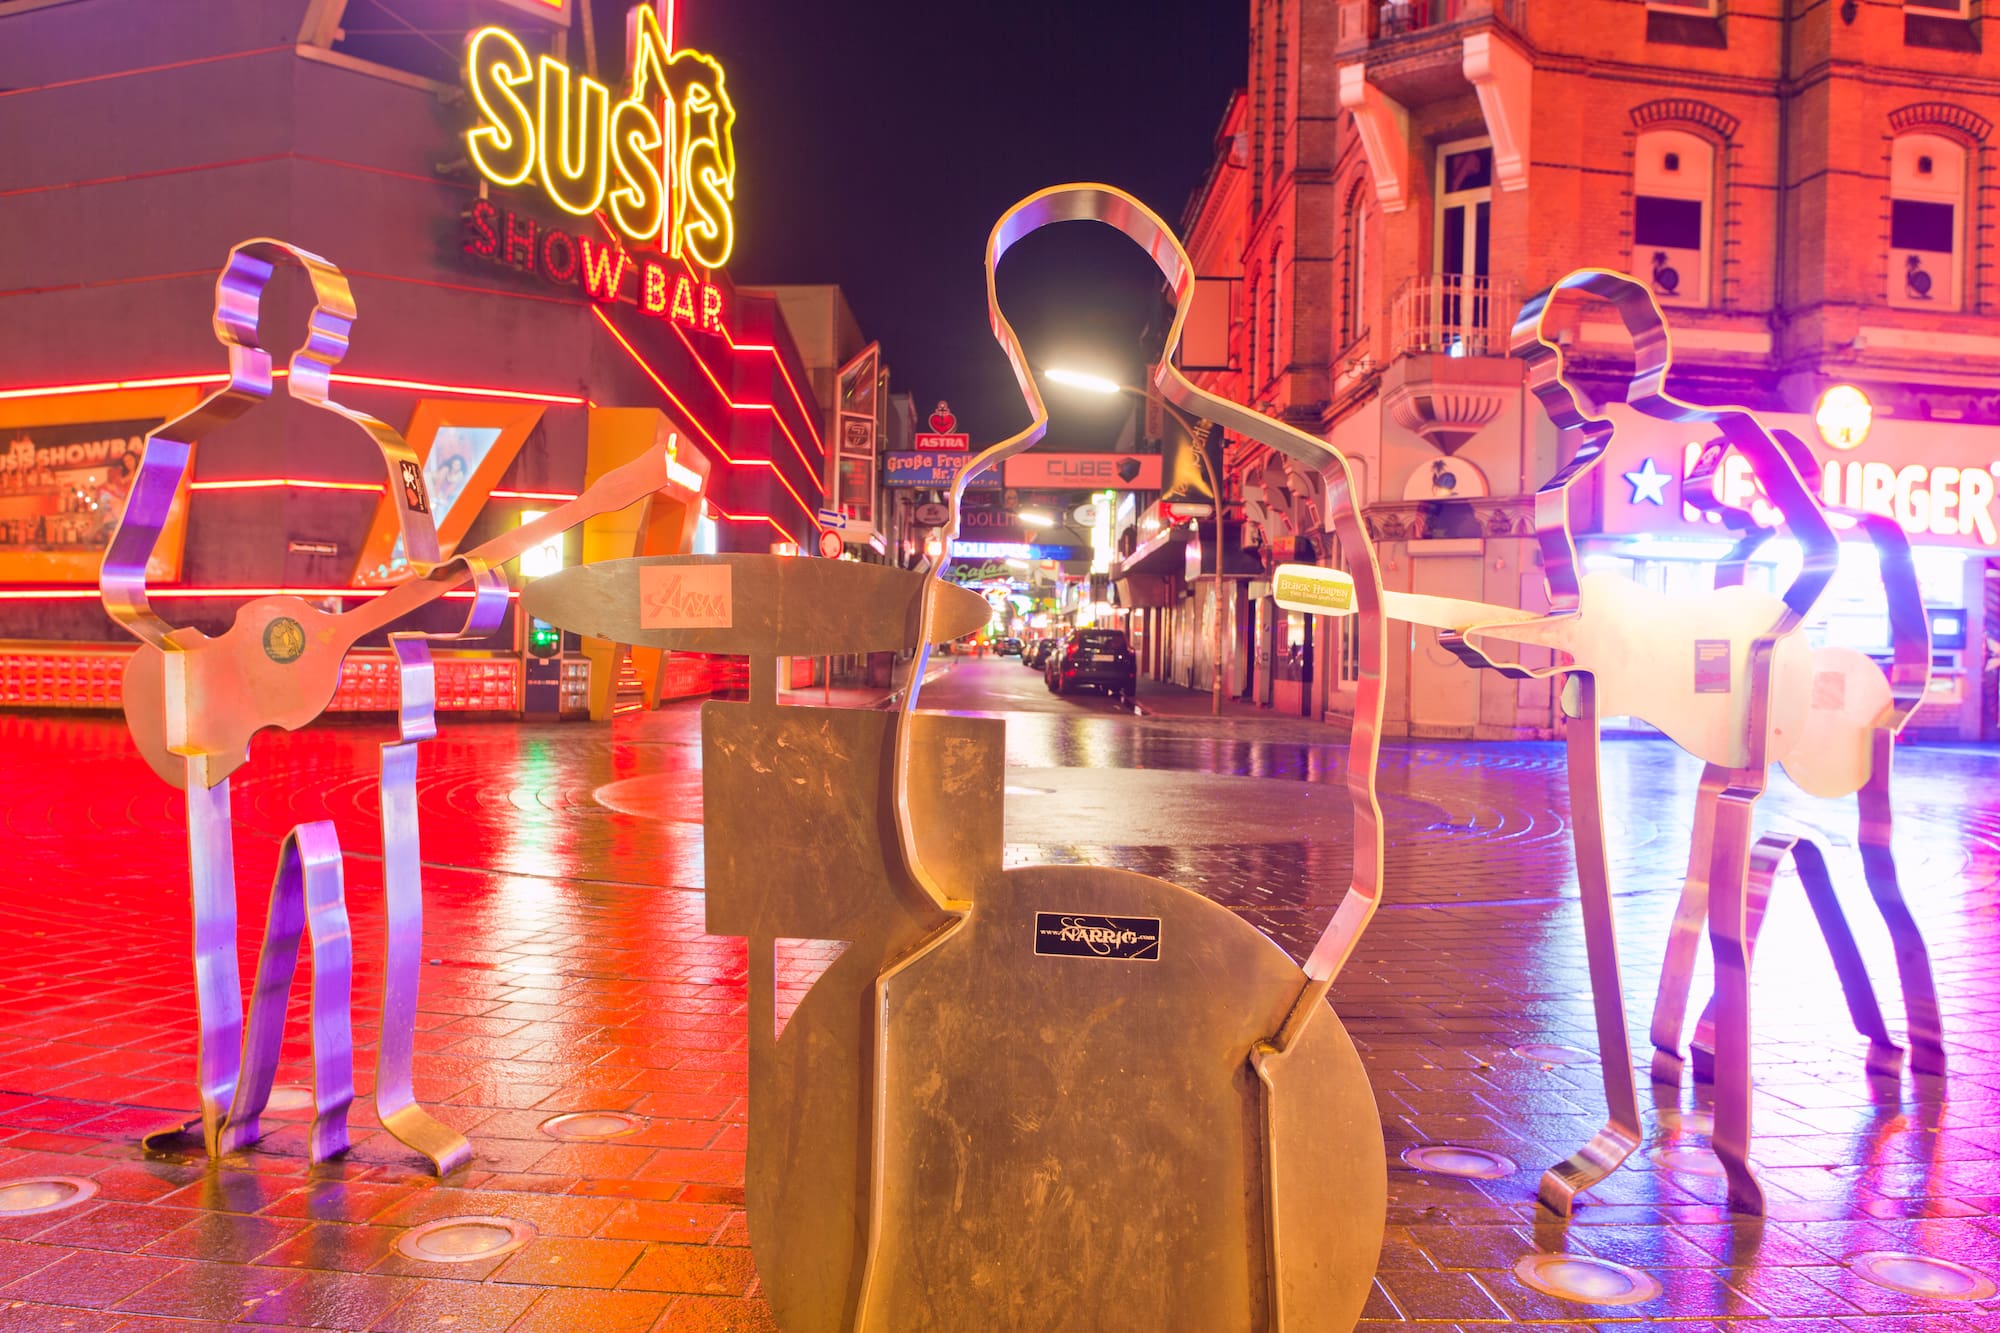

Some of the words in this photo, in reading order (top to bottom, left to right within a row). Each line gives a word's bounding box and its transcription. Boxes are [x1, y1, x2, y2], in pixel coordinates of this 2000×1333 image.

[464, 199, 627, 304] SHOW
[639, 260, 725, 332] BAR
[36, 435, 144, 467] SHOWBA
[919, 437, 965, 448] ASTRA
[887, 454, 933, 472] Große
[1047, 460, 1113, 476] CUBE
